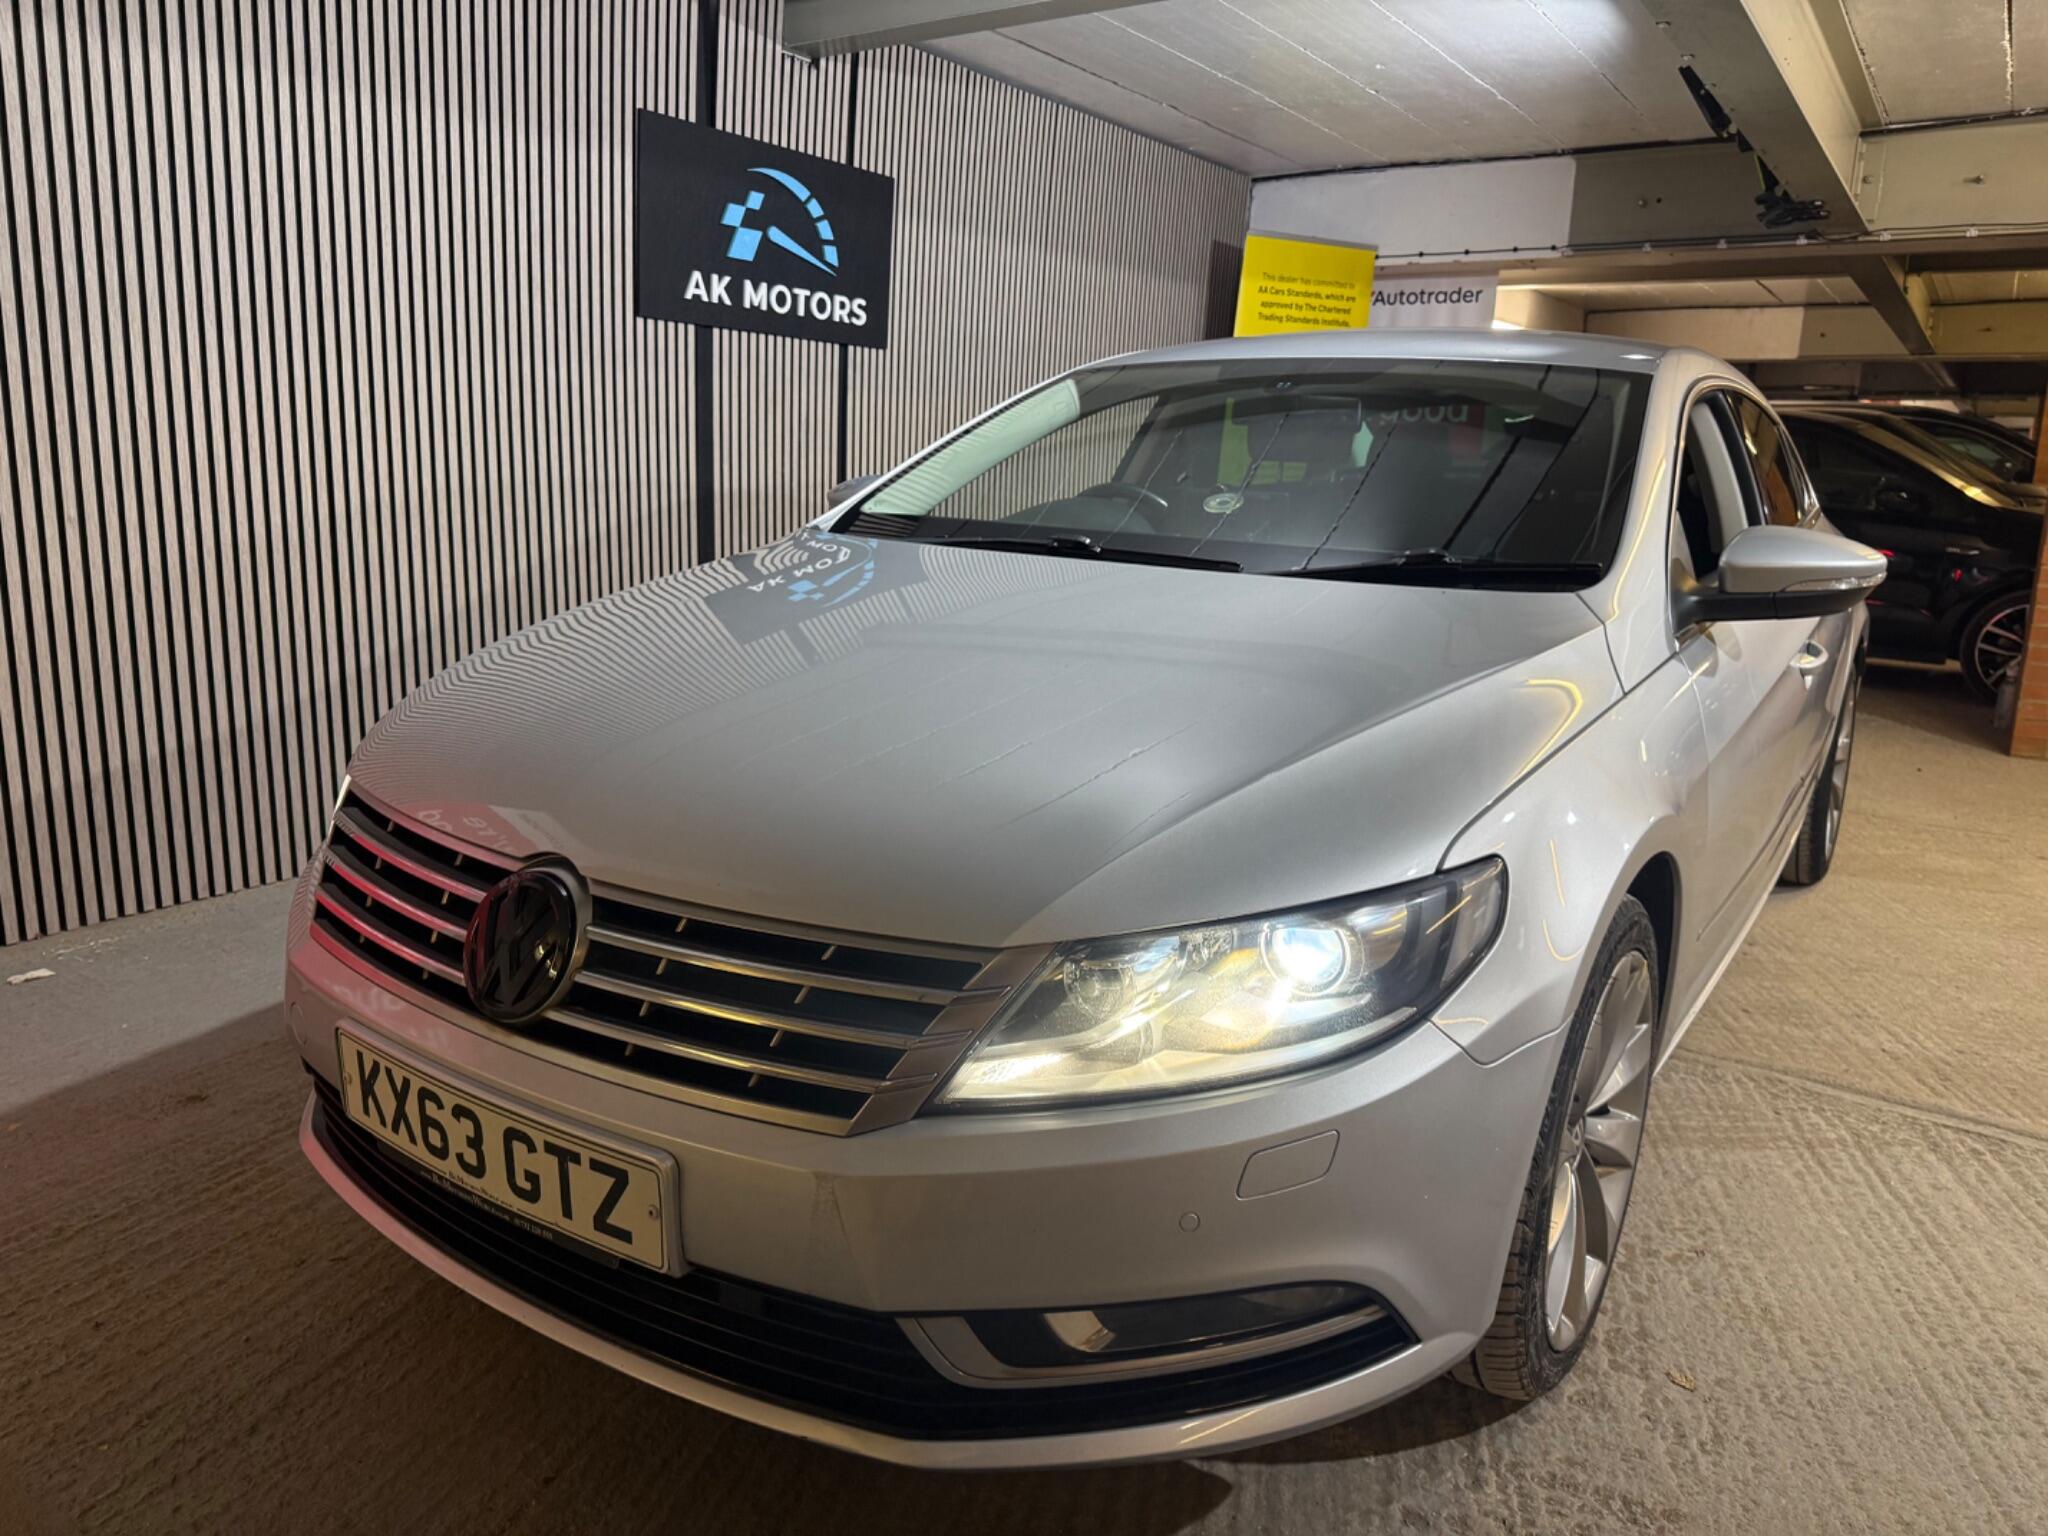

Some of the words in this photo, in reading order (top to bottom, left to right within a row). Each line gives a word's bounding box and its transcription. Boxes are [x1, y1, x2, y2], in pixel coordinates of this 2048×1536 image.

[683, 270, 732, 306] AK
[742, 278, 867, 326] MOTORS
[1270, 286, 1285, 296] Cars
[1325, 293, 1345, 302] which
[1346, 295, 1356, 303] are
[1372, 286, 1483, 306] Autotrader
[1260, 301, 1293, 311] approved
[1294, 303, 1303, 312] by
[1304, 303, 1317, 312] The
[1318, 305, 1351, 314] Chartered
[1258, 312, 1284, 323] Trading
[1285, 314, 1320, 325] Standards
[356, 1050, 487, 1180] KX63
[503, 1126, 633, 1245] GTZ
